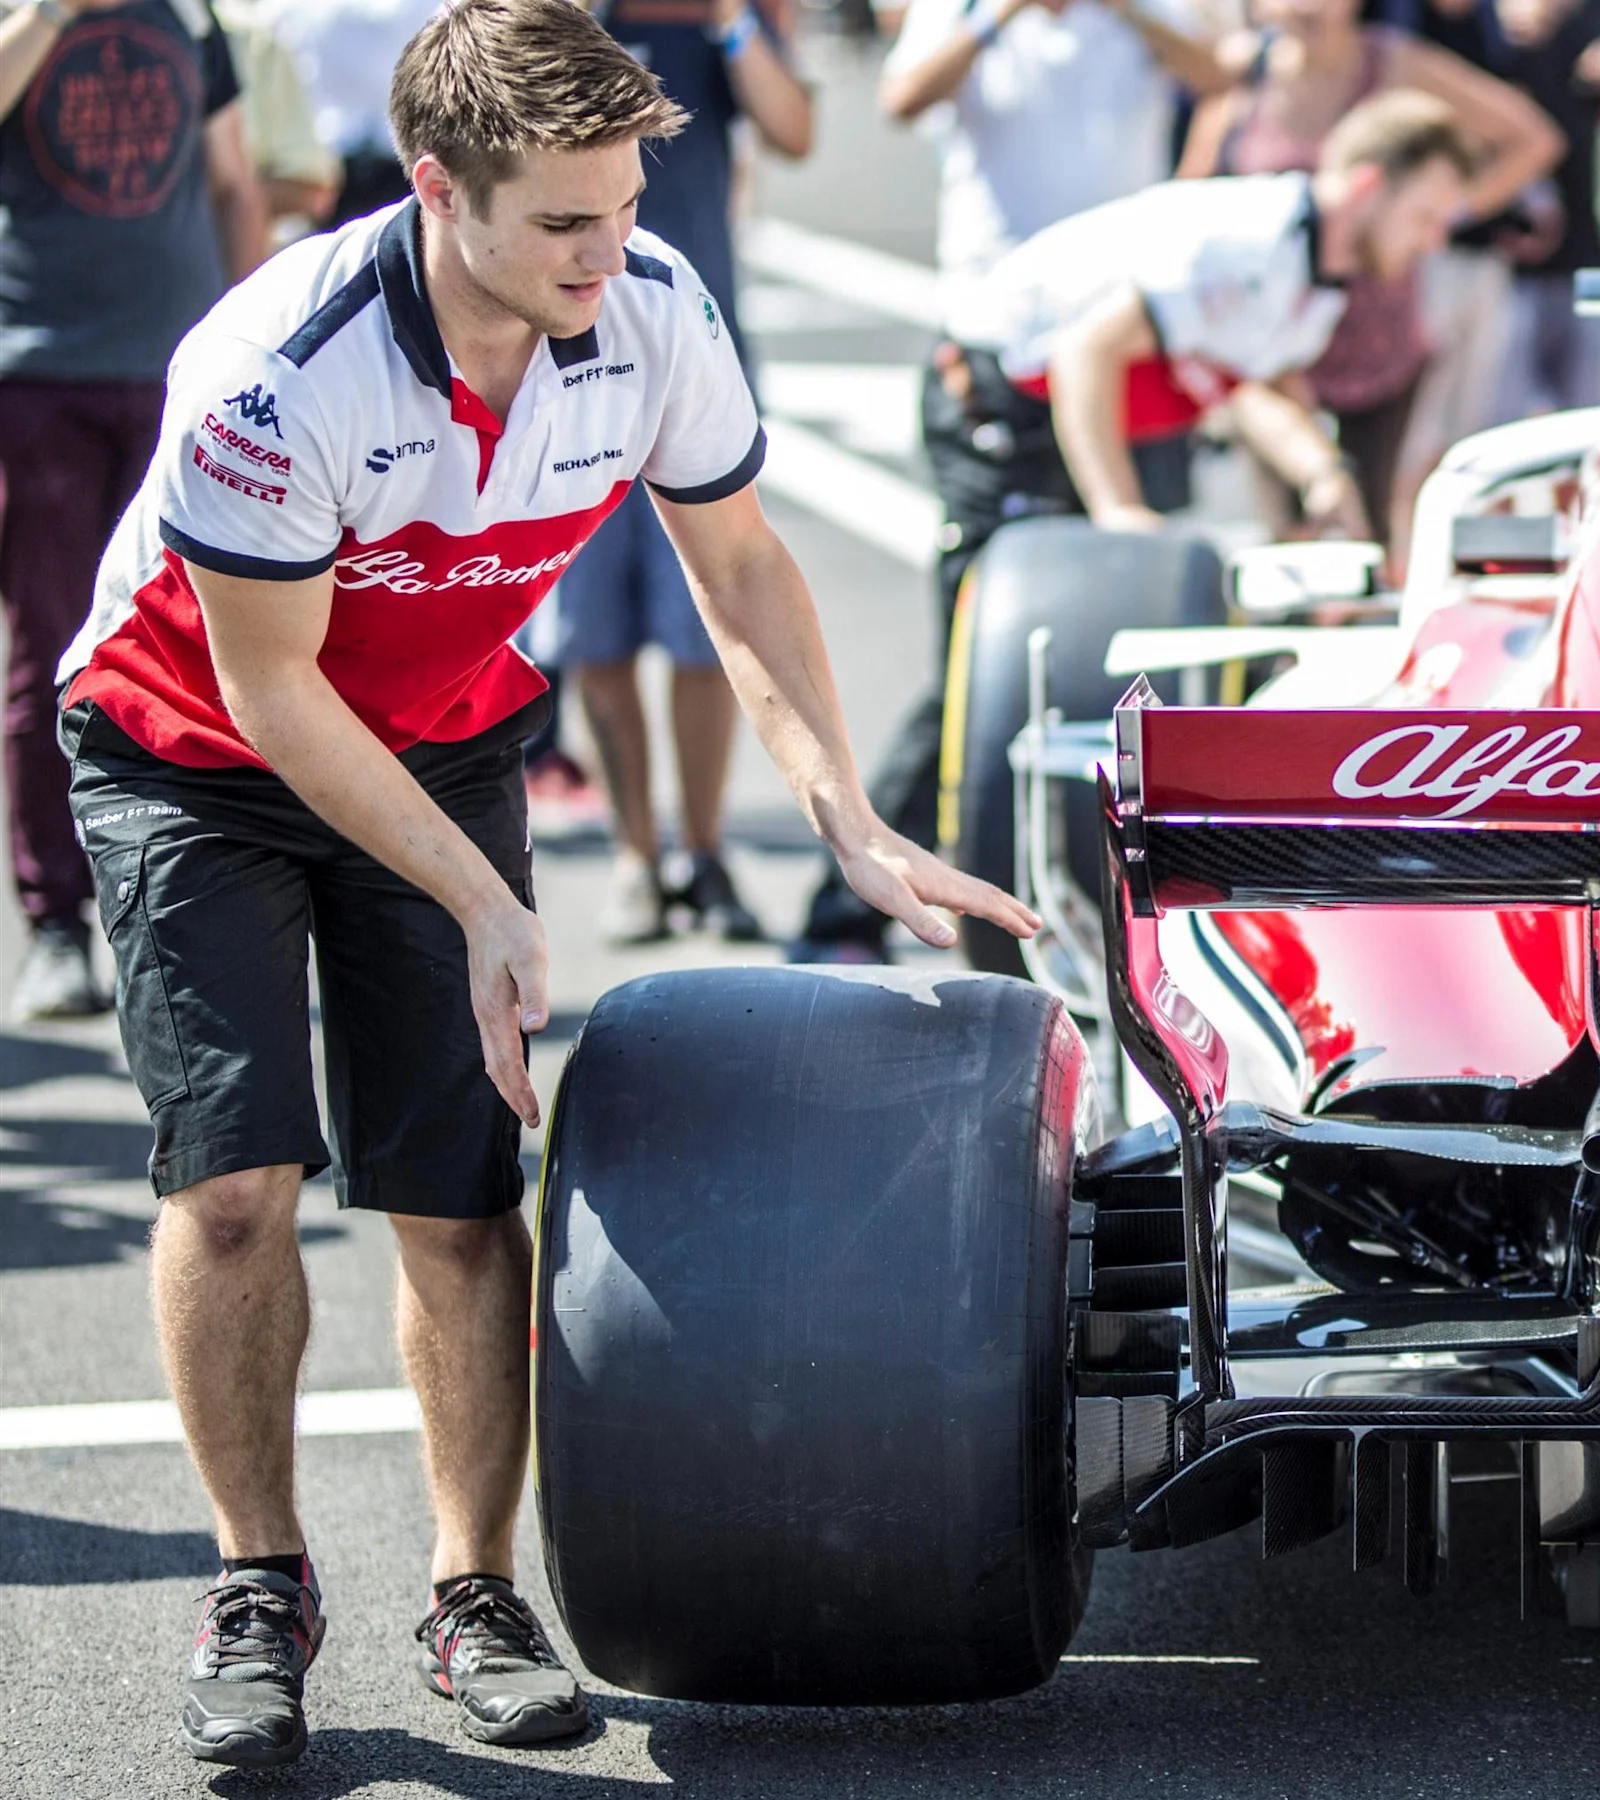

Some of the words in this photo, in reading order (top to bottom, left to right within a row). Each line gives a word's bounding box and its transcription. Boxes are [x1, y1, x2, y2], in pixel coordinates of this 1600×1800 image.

[205, 412, 292, 472] CARRERA
[553, 451, 602, 474] RICHARD
[602, 448, 625, 460] MIL
[193, 443, 287, 505] PIRELLI
[85, 810, 124, 830] Sauber
[147, 805, 183, 816] Team
